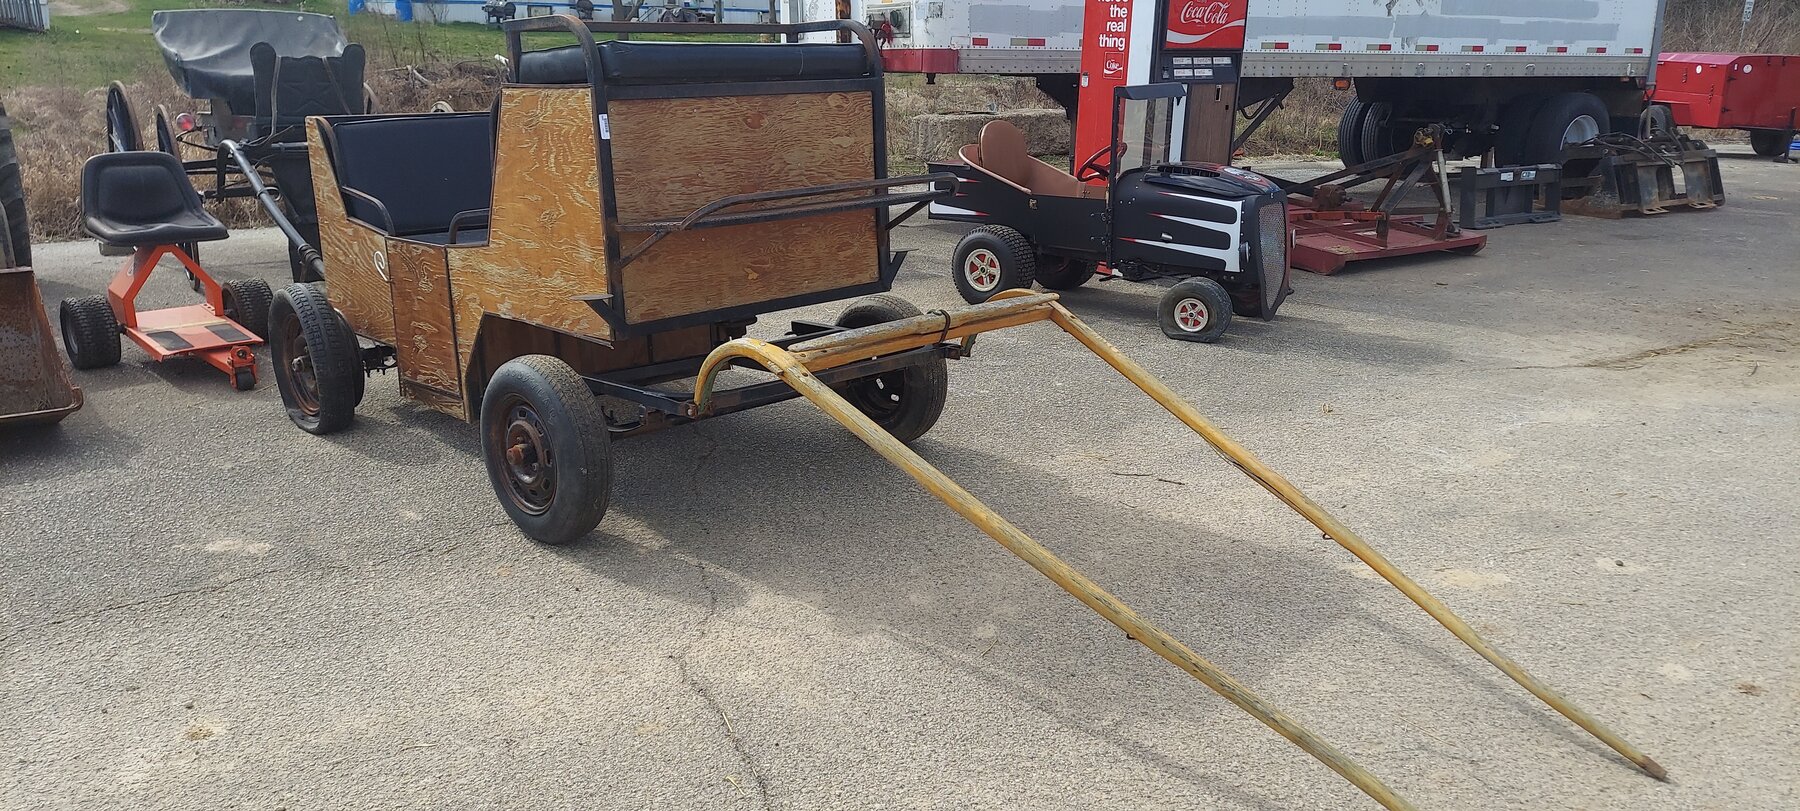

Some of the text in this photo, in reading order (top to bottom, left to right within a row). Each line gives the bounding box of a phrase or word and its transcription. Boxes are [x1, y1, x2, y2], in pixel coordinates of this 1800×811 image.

[1110, 4, 1128, 18] the
[1106, 19, 1127, 32] real
[1099, 33, 1126, 51] thing
